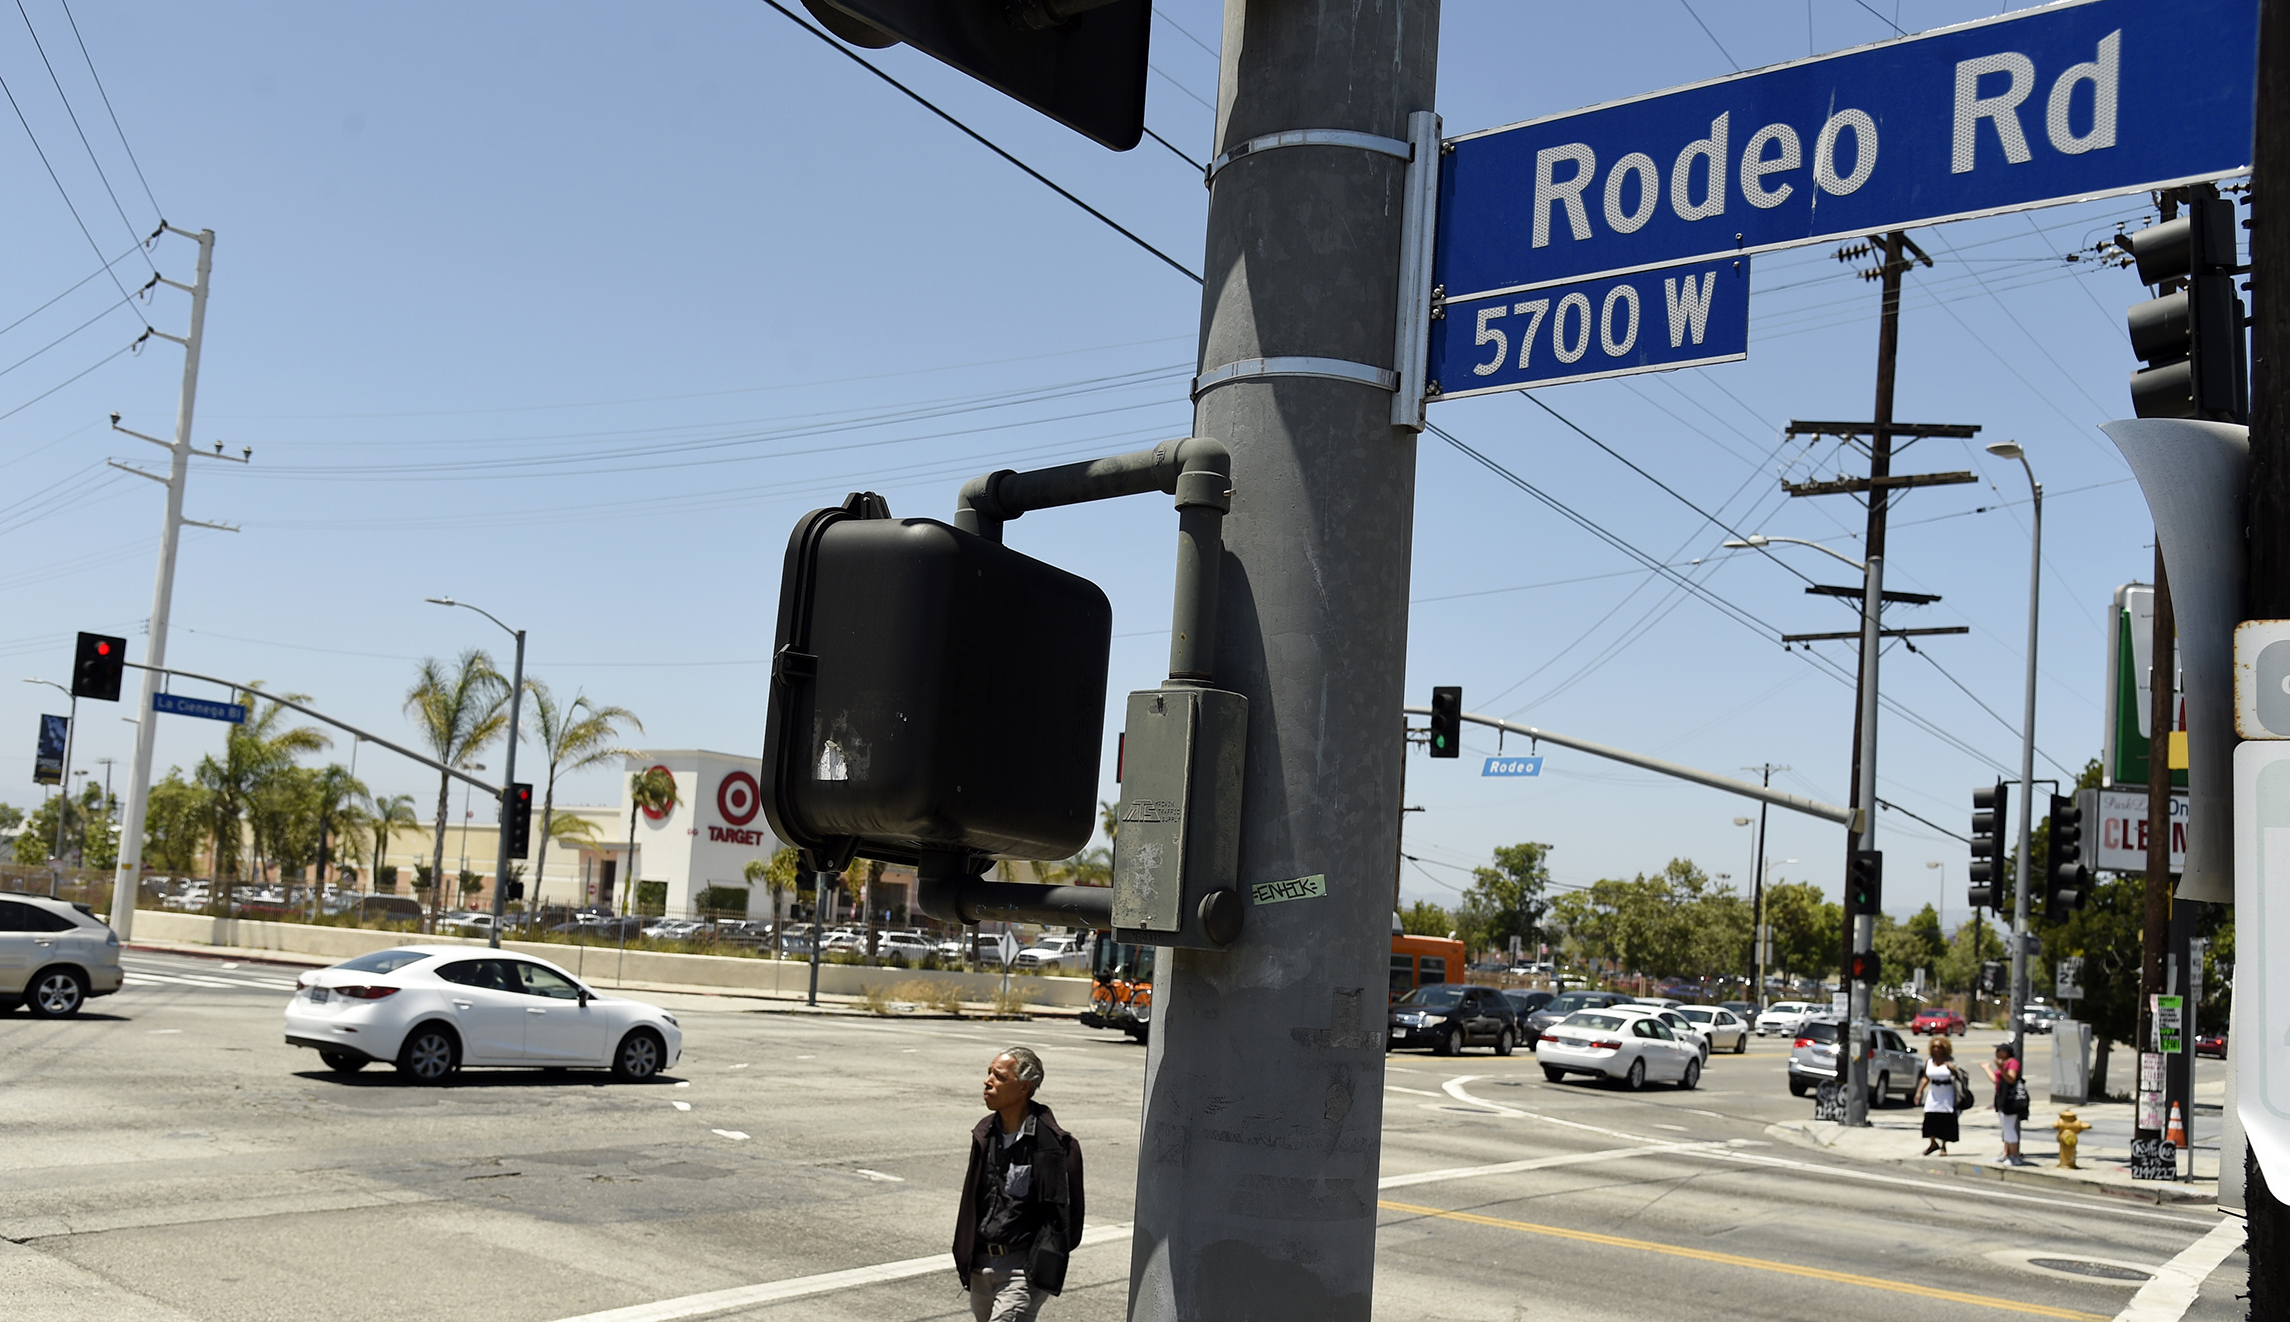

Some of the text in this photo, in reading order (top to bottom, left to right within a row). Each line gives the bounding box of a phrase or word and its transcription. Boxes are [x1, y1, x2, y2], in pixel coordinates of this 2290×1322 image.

[1531, 28, 2122, 249] Rodeo Rd
[1472, 270, 1717, 376] 5700 W
[157, 696, 174, 709] La
[177, 700, 225, 718] Cienega
[1489, 760, 1535, 773] Rodeo
[708, 825, 764, 846] TARGET
